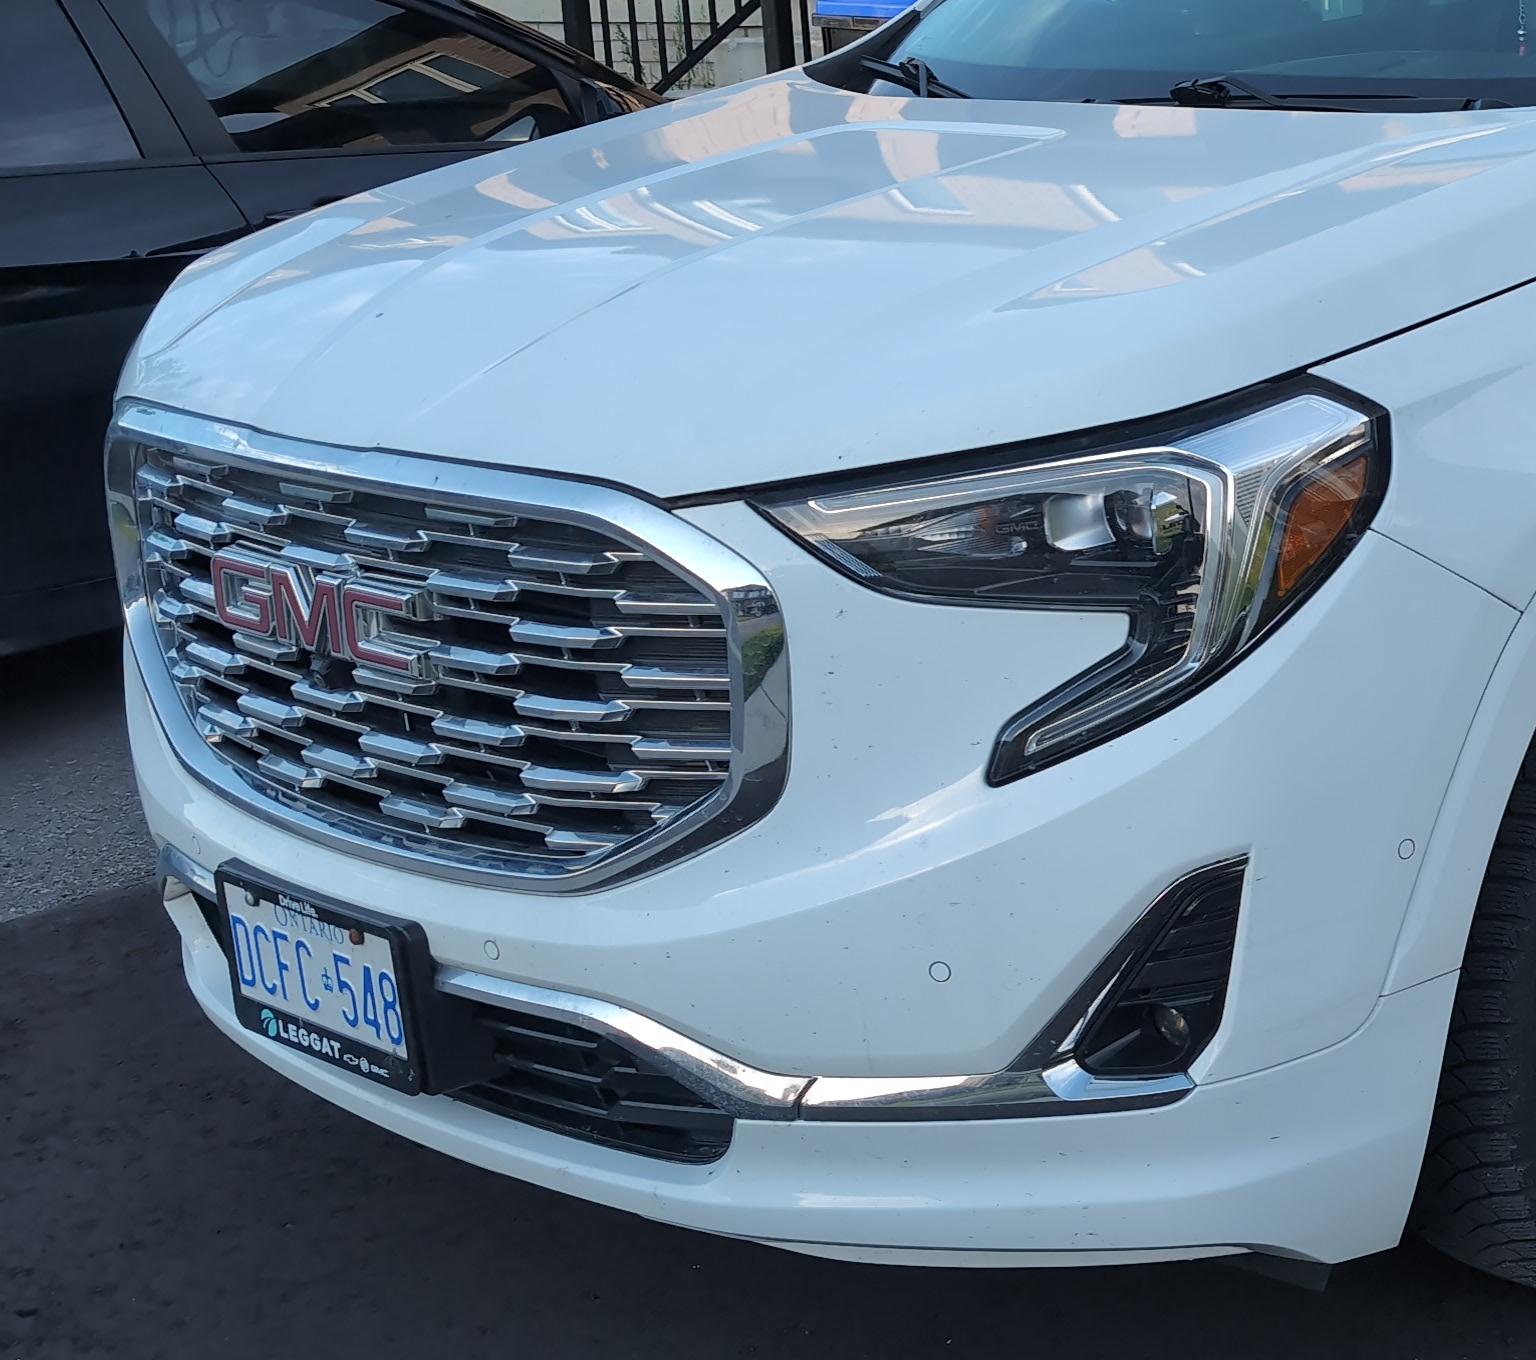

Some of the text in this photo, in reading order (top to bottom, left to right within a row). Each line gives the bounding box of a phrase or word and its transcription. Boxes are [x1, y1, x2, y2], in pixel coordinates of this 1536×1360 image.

[995, 520, 1040, 534] GMC
[212, 550, 418, 678] GMC
[274, 904, 344, 944] ONTARIO
[230, 913, 403, 1046] DCFC 548
[278, 1019, 341, 1059] LEGGAT
